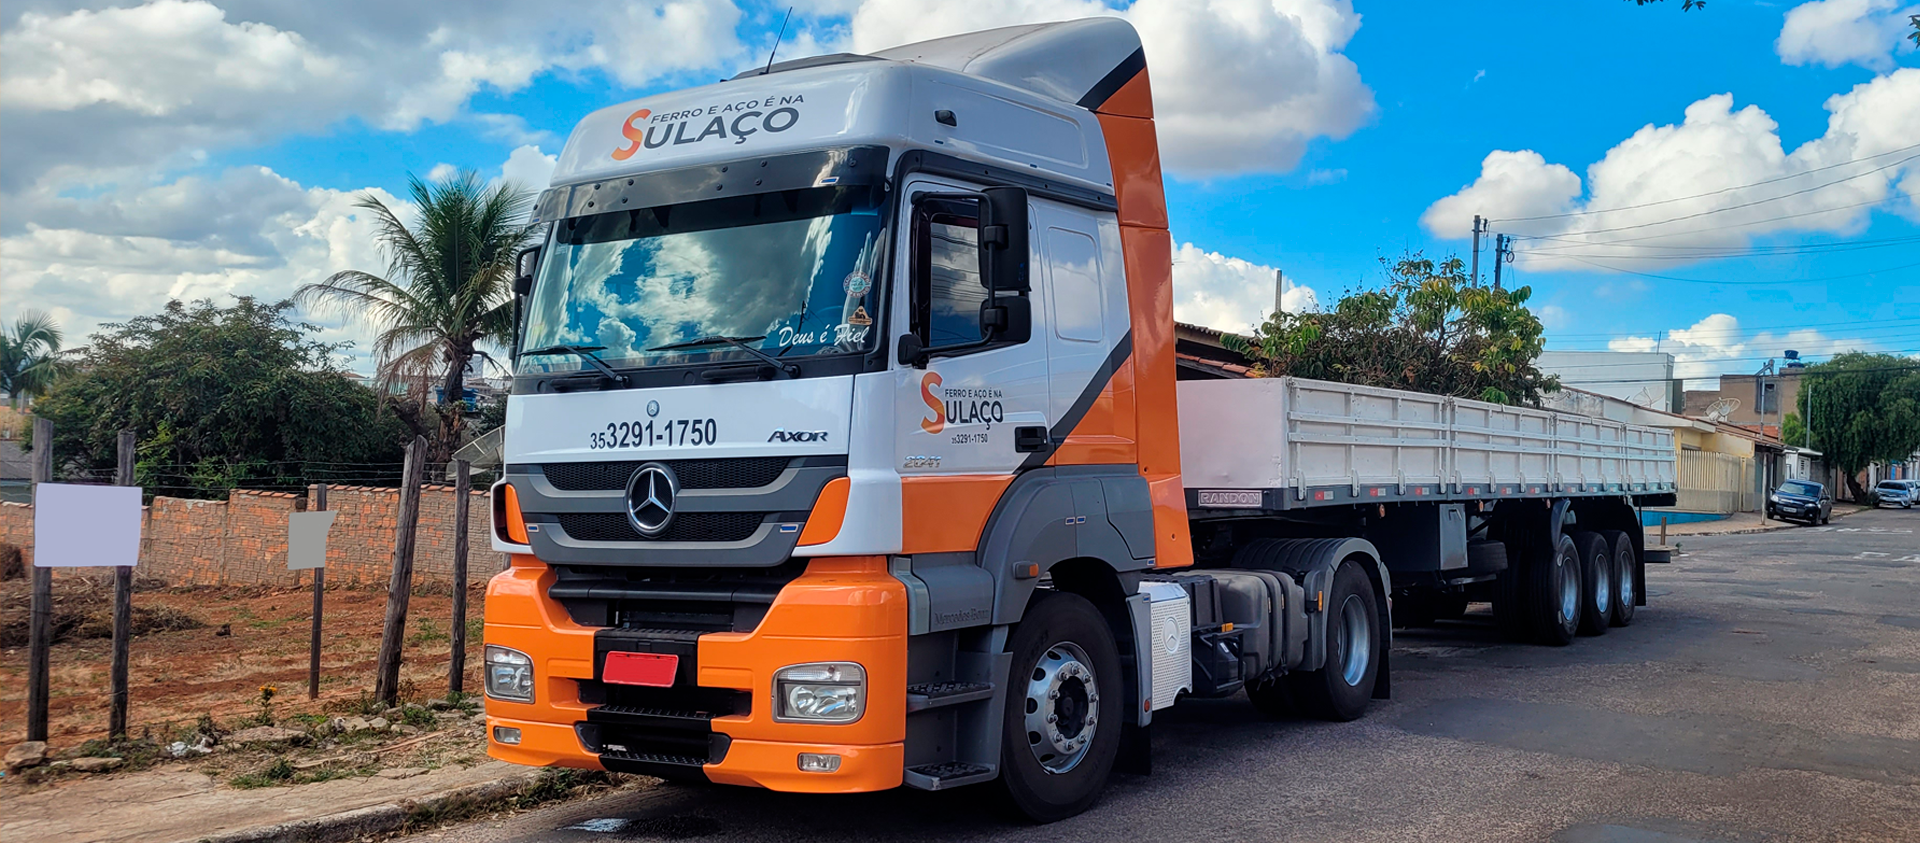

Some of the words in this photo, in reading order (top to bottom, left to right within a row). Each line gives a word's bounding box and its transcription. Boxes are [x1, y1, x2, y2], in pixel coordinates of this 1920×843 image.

[651, 108, 703, 124] FERRO
[707, 105, 719, 115] E
[722, 100, 759, 114] AÇO
[764, 95, 775, 107] É
[780, 95, 805, 105] NA
[611, 108, 800, 161] SULAÇO
[779, 326, 814, 347] Deus
[820, 324, 831, 343] é
[833, 323, 870, 346] Fiel
[921, 371, 1003, 434] SULAÇO
[945, 389, 967, 398] FERRO
[974, 389, 987, 399] AÇO
[994, 389, 1003, 398] NA
[1200, 492, 1259, 504] RANDON
